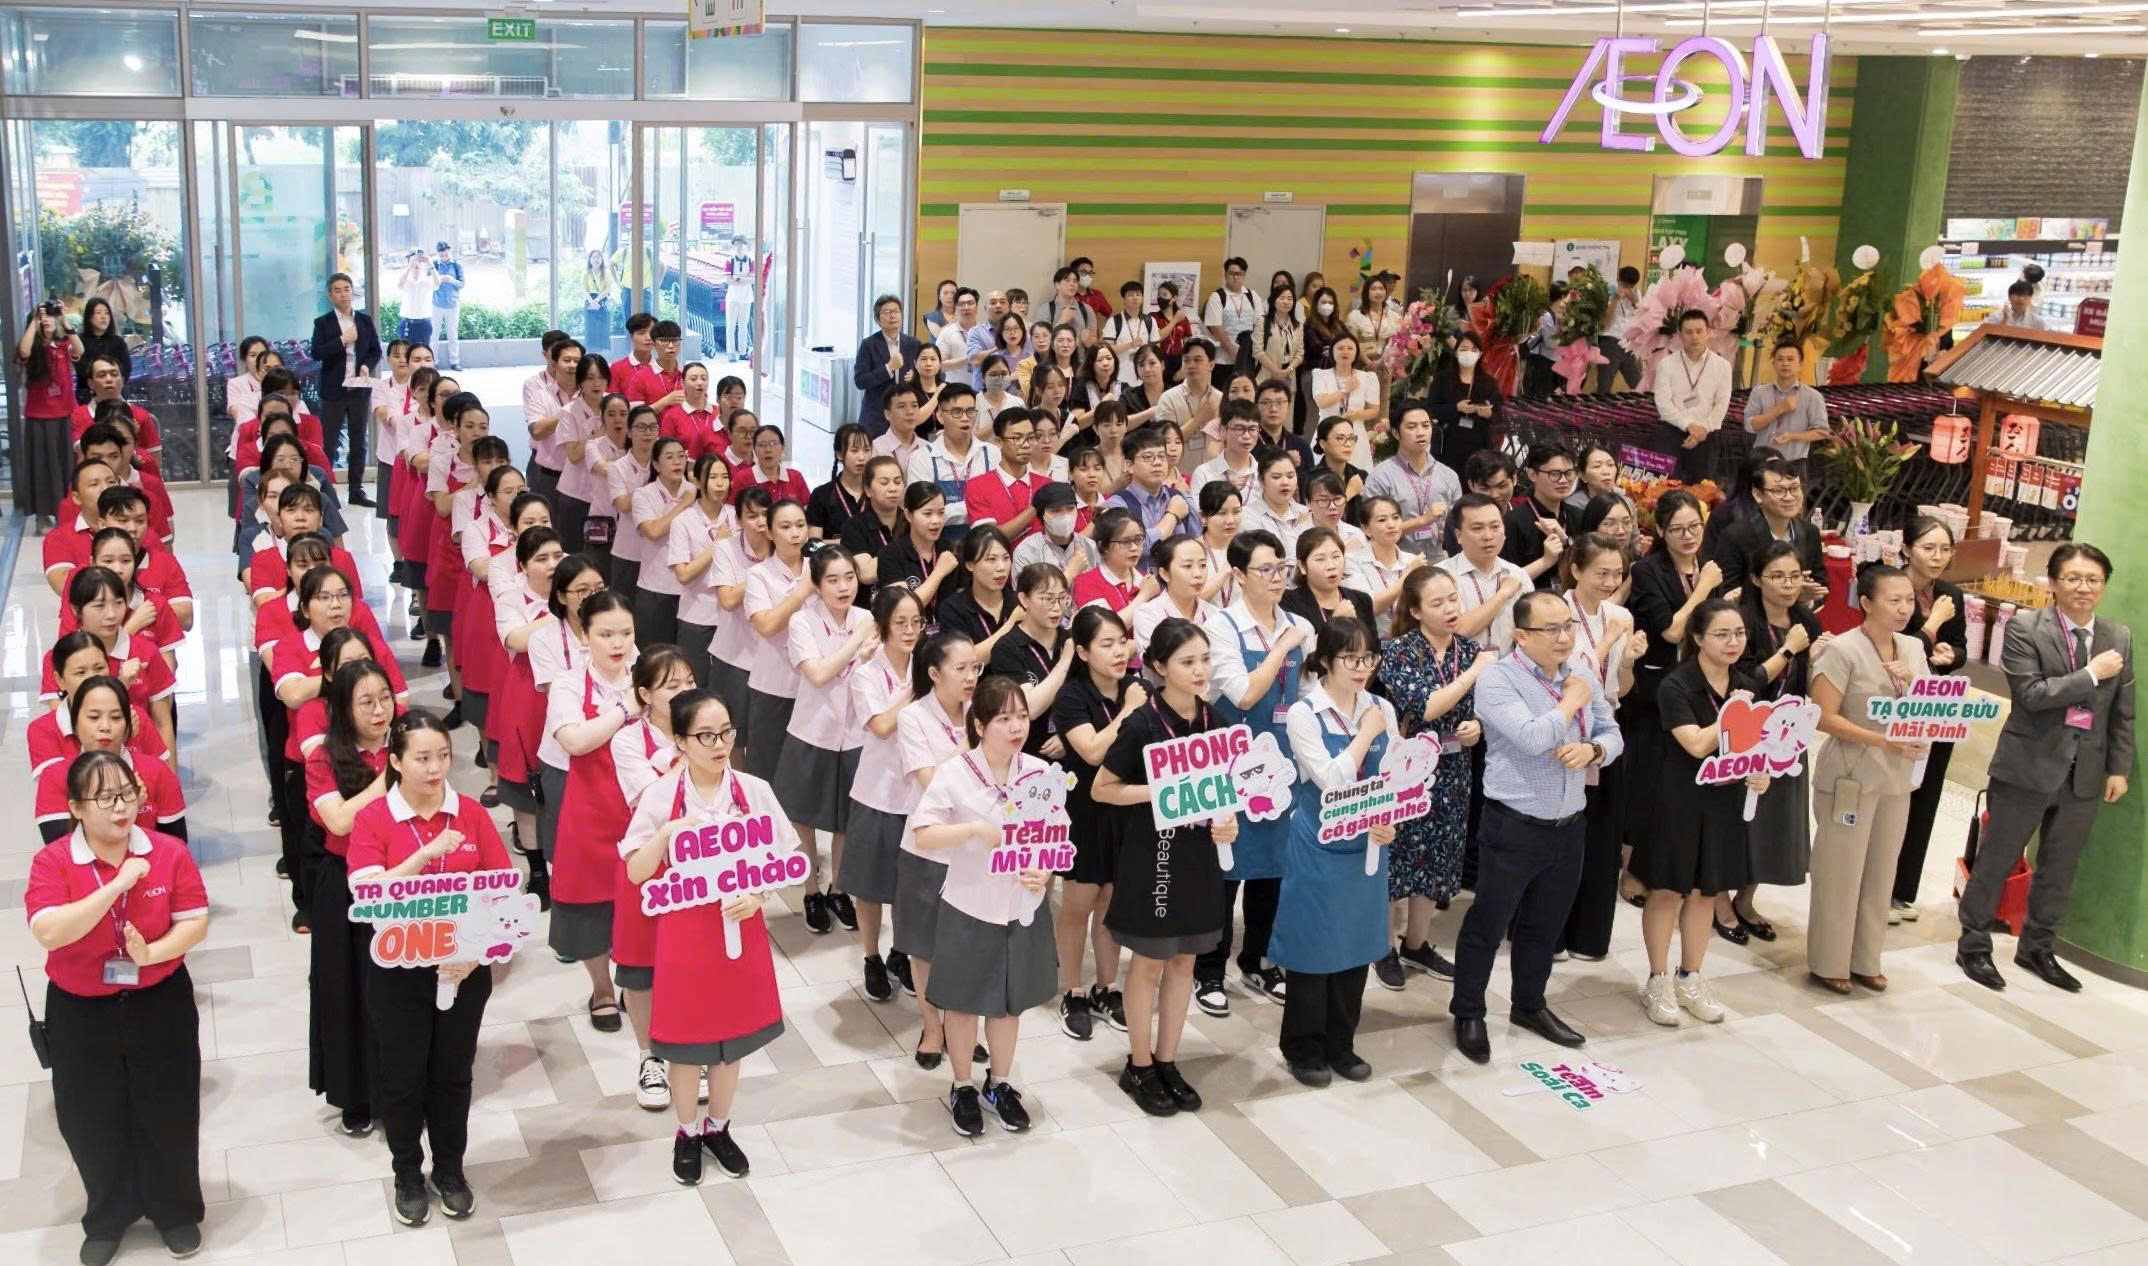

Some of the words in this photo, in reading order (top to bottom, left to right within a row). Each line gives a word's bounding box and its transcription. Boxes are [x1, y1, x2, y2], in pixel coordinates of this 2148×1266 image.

[492, 22, 531, 37] EXIT
[1912, 679, 1967, 696] AEON
[1871, 700, 1892, 720] TẠ
[1896, 701, 1958, 720] QUANG
[1961, 698, 1999, 718] BỬU
[1890, 721, 1925, 737] Mãi
[1150, 729, 1249, 779] PHONG
[1700, 753, 1767, 781] AEON
[1159, 775, 1238, 819] CÁCH
[1325, 785, 1369, 804] Chúng
[1370, 779, 1384, 792] ta
[1323, 803, 1358, 820] cùng
[1360, 792, 1395, 810] nhau
[675, 815, 774, 863] AEON
[1002, 823, 1067, 846] Team
[1322, 817, 1346, 841] cố
[991, 846, 1032, 876] Mỹ
[1038, 844, 1075, 870] Nữ
[1155, 827, 1175, 918] Beautique
[355, 884, 383, 904] TẠ
[389, 876, 467, 901] QUANG
[647, 872, 708, 910] xin
[717, 852, 807, 893] chào
[353, 895, 469, 919] NUMBER
[377, 920, 457, 962] ONE
[1520, 1063, 1573, 1091] Soái
[1562, 1092, 1591, 1109] Ca
[1551, 1064, 1605, 1099] Team
